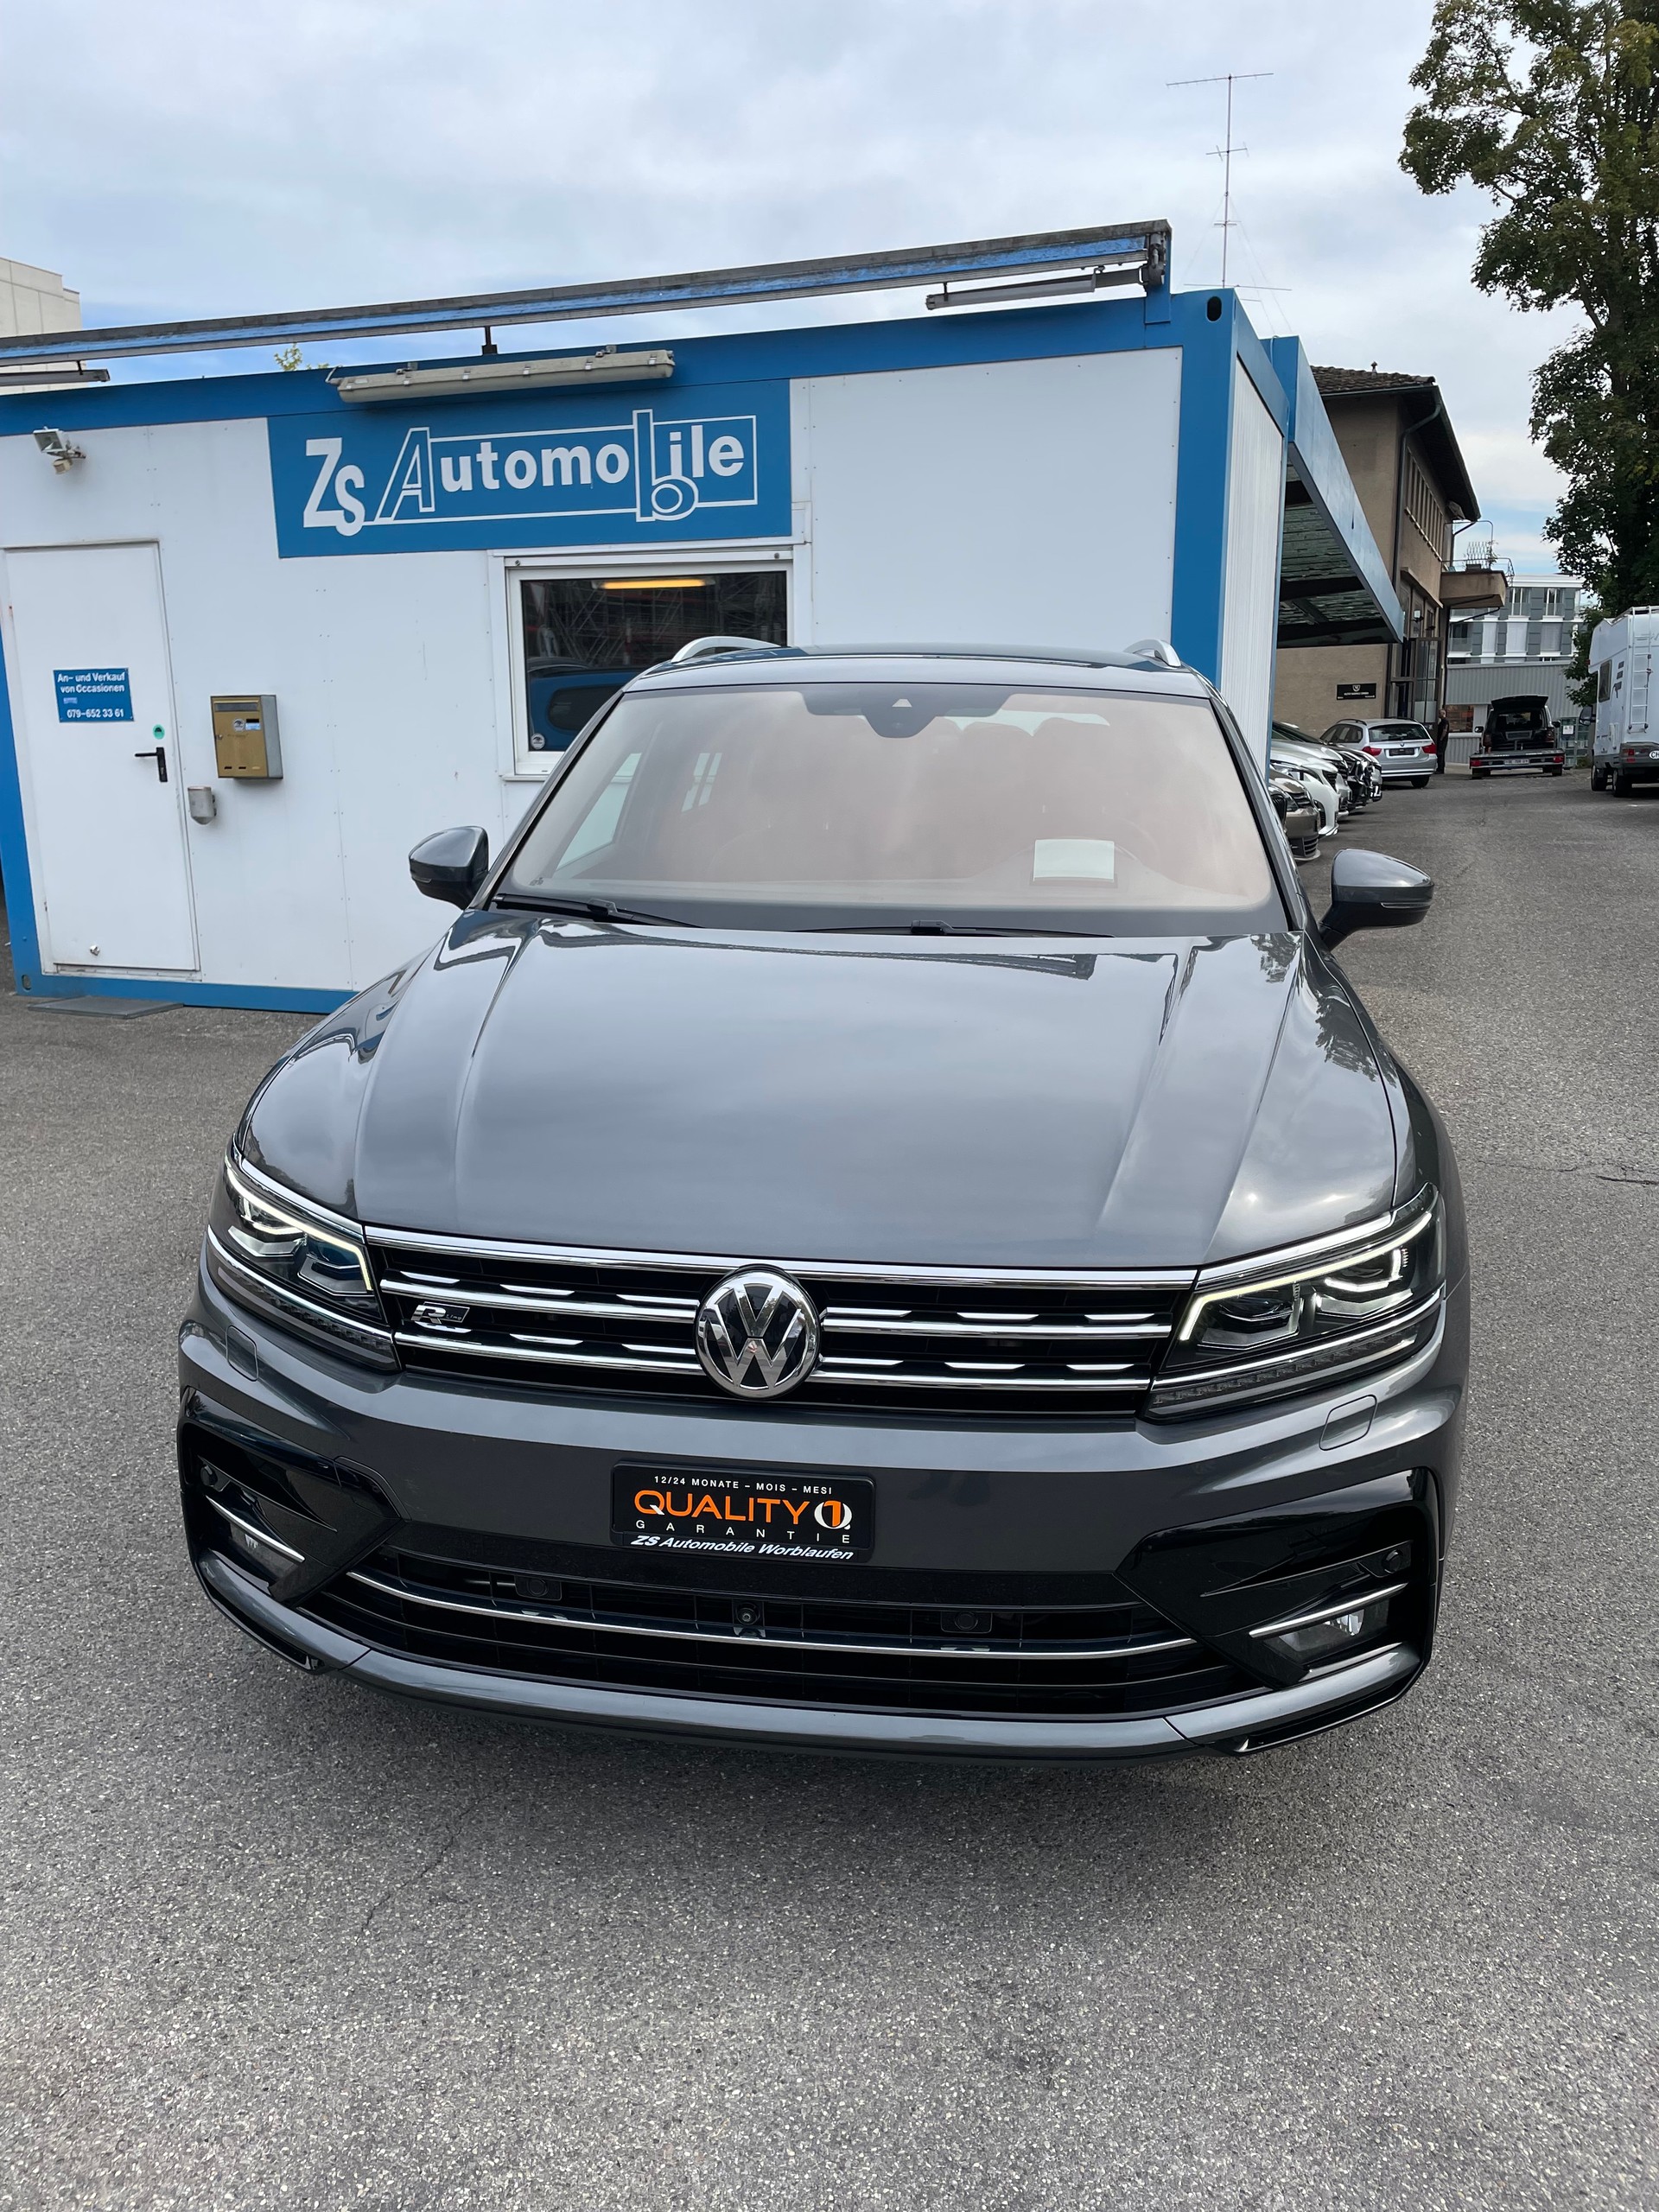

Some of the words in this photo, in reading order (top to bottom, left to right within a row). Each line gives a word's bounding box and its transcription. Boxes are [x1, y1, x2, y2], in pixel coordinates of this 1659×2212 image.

[374, 409, 746, 523] Automobile
[57, 673, 73, 683] An-
[75, 673, 91, 682] und
[92, 671, 125, 682] Verkauf
[76, 683, 125, 693] Occasionen
[67, 709, 101, 718] 079-652
[103, 709, 113, 717] 33
[114, 709, 124, 717] 61
[654, 1476, 686, 1485] 12/24
[691, 1478, 740, 1489] MONATE
[756, 1483, 786, 1492] MOIS
[803, 1486, 832, 1495] MESI
[634, 1490, 810, 1525] QUALITY
[630, 1535, 661, 1547] ZS
[658, 1537, 756, 1554] Automobile
[758, 1543, 855, 1560] Worblaufen
